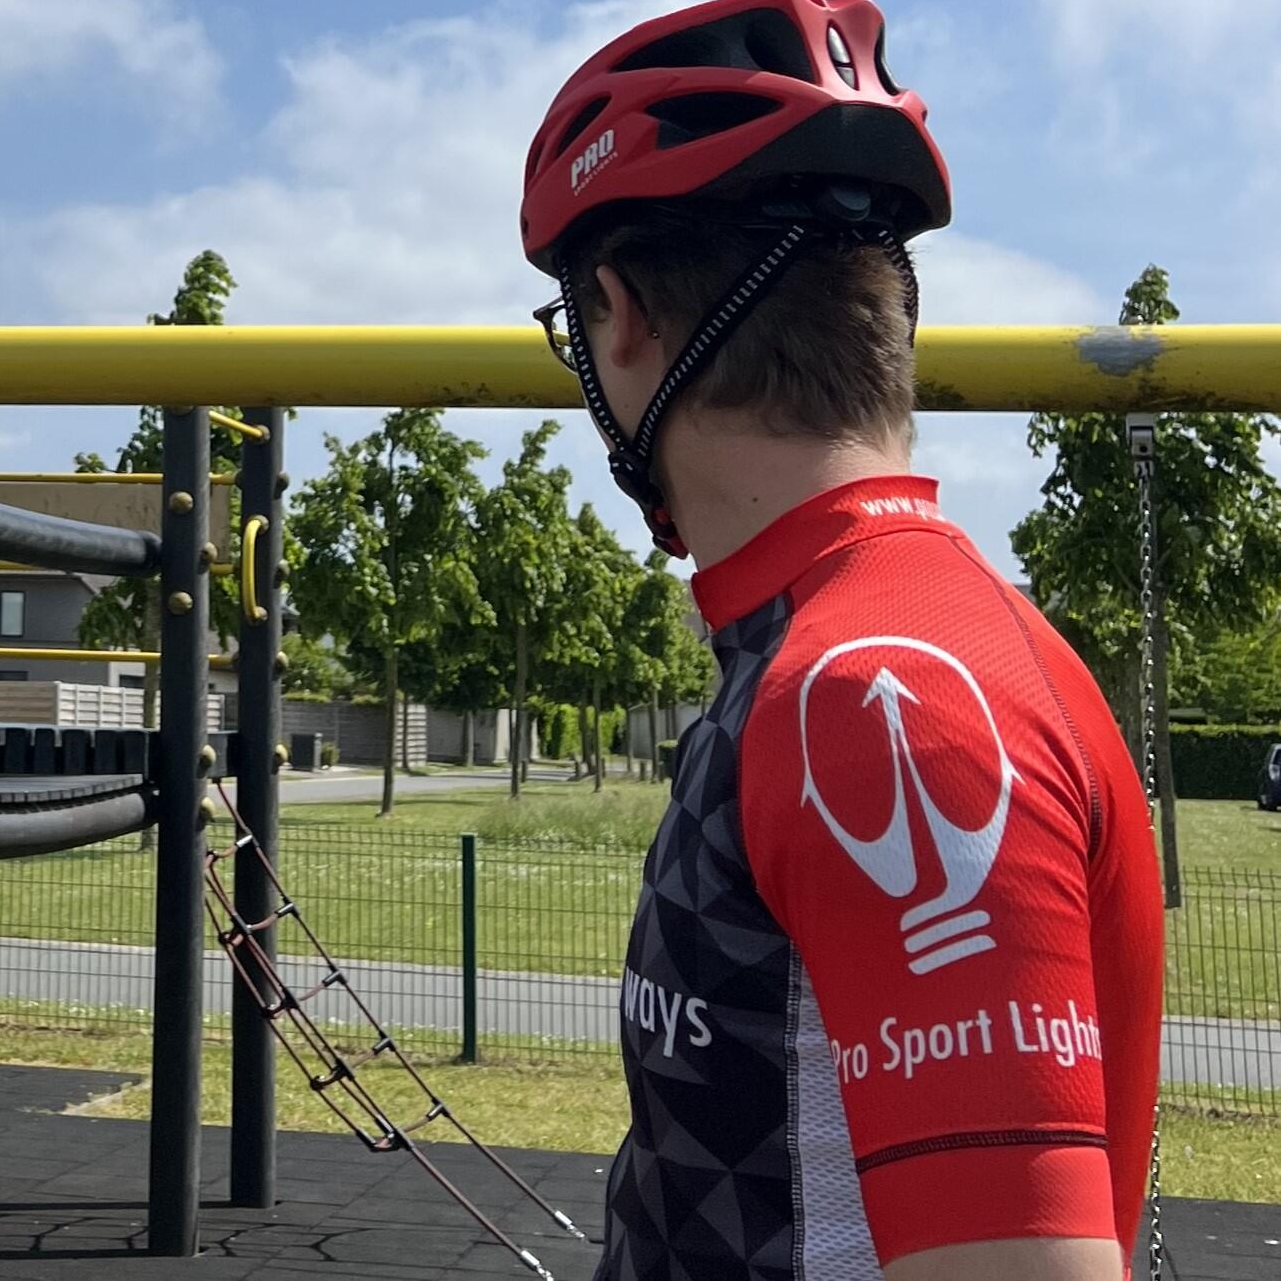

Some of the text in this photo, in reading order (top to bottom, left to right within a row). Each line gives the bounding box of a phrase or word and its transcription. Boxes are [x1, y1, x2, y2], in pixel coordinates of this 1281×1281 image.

[571, 129, 615, 188] PRO
[830, 1038, 868, 1084] Pro
[879, 1008, 993, 1080] Sport
